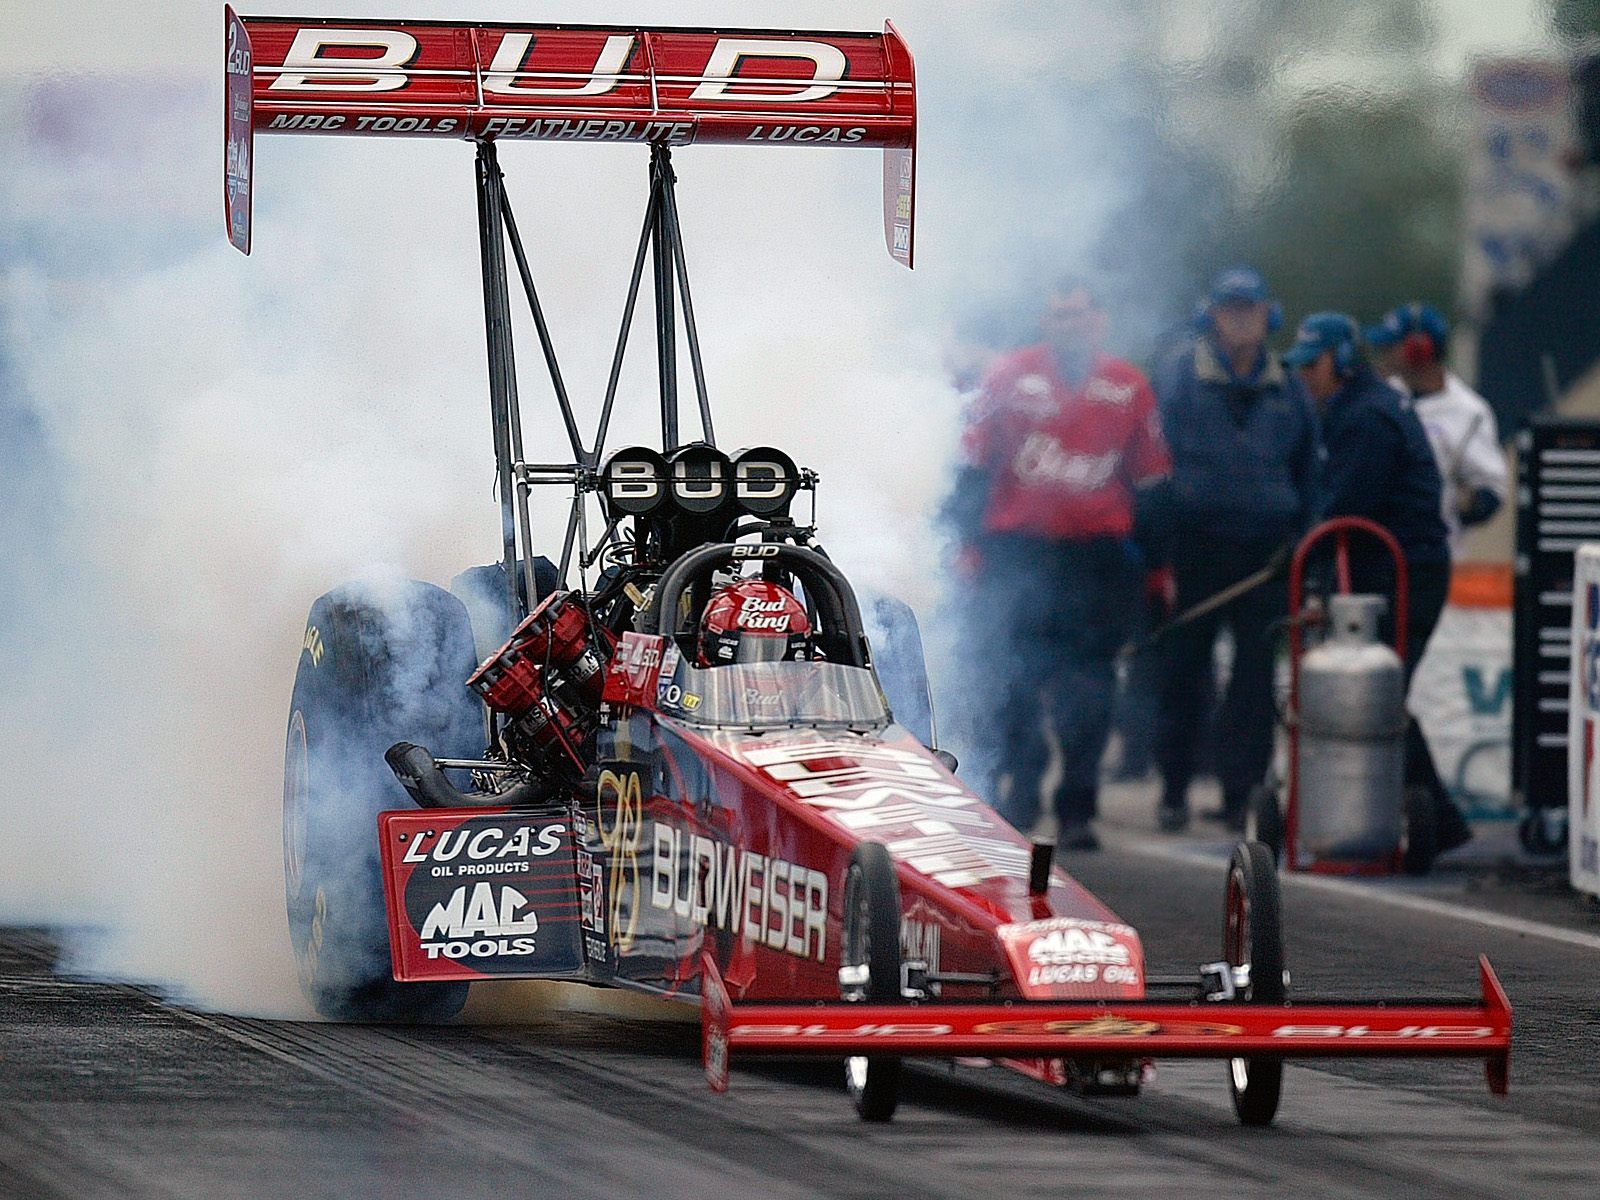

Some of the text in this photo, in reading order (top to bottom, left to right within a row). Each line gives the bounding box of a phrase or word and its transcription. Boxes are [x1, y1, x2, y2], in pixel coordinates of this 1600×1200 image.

[267, 28, 849, 102] BUD
[268, 113, 459, 133] MAC TOOLS
[479, 117, 694, 142] FEATHERLITE
[746, 125, 867, 143] LUCAS
[610, 461, 785, 499] BUD
[731, 546, 780, 557] BUD
[741, 596, 787, 612] Bud
[737, 611, 791, 632] King
[402, 824, 567, 864] LUCAS
[431, 861, 530, 877] OIL PRODUCTS
[652, 821, 829, 963] BUDWEISER
[420, 881, 539, 940] MAC
[420, 938, 536, 959] TOOLS
[1028, 964, 1140, 986] LUCAS OIL
